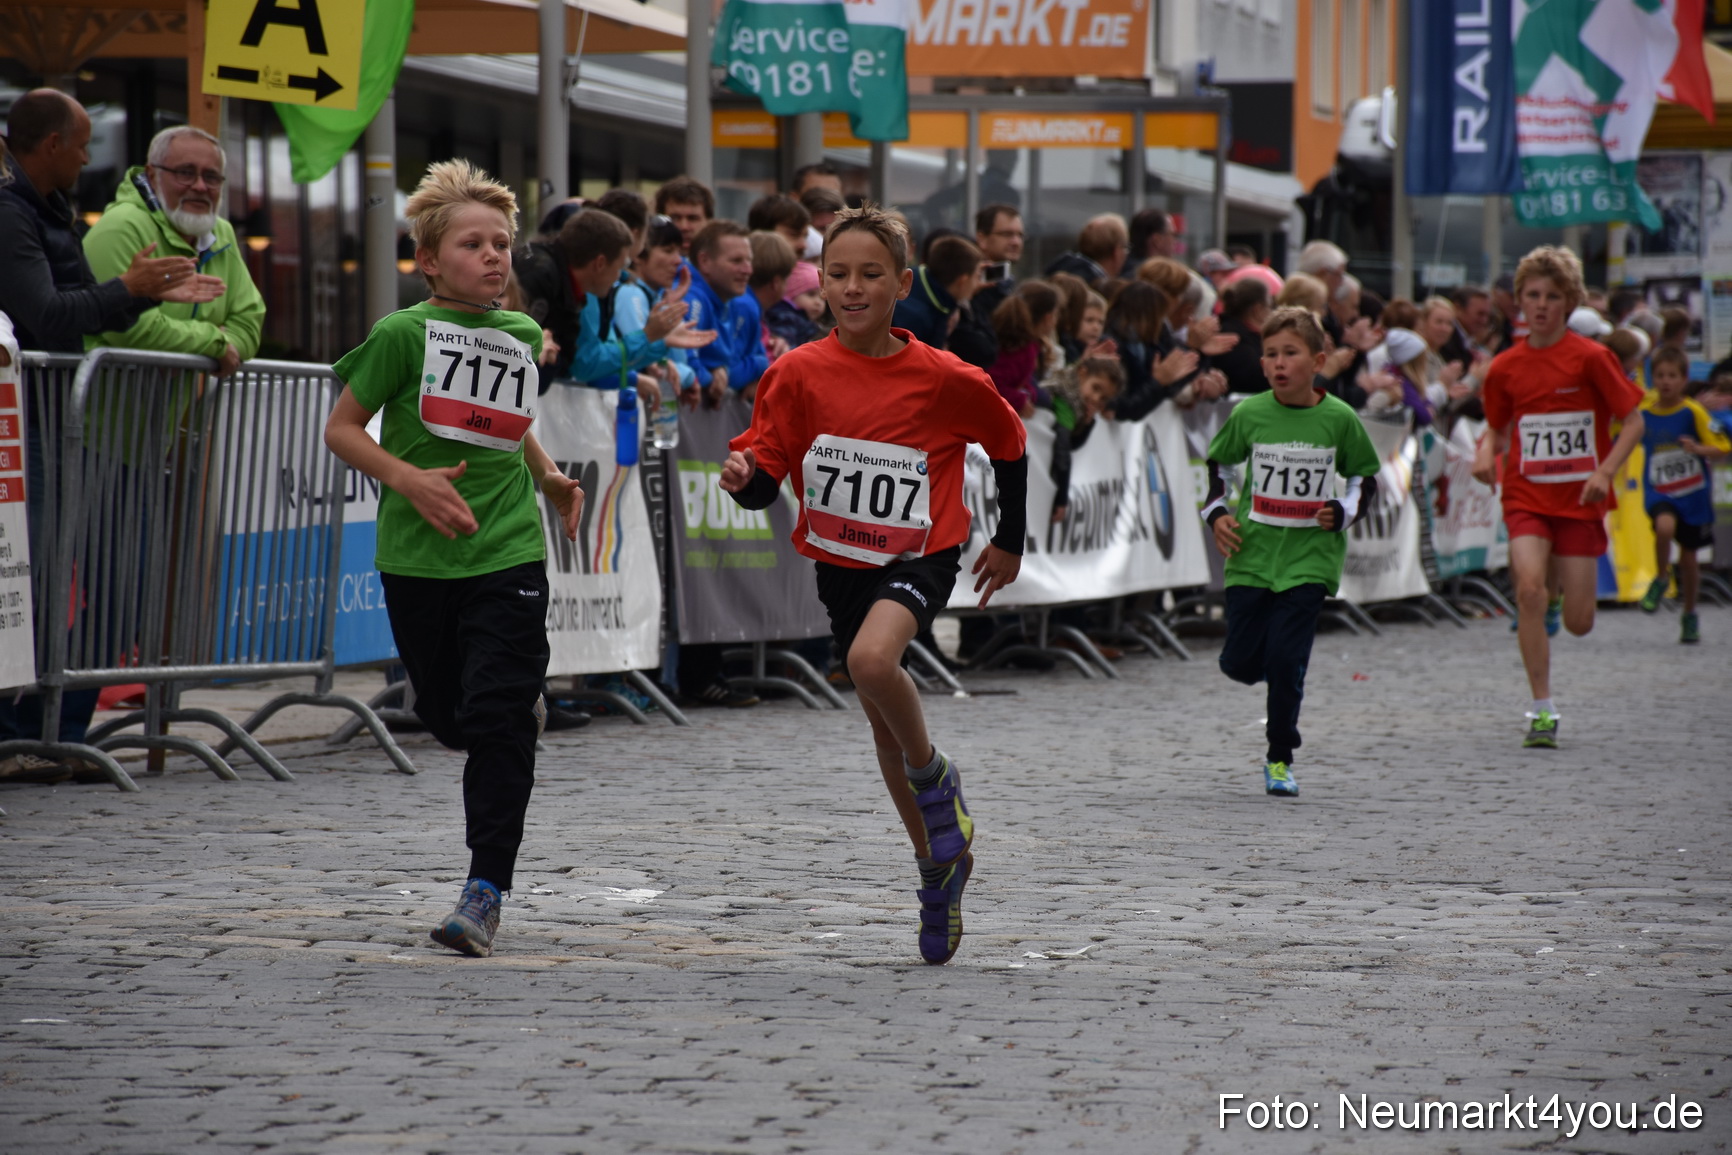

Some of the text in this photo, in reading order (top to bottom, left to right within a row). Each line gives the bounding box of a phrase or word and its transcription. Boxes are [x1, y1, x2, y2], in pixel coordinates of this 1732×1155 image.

[240, 0, 329, 56] A
[429, 330, 523, 360] PARTL Neumarkt
[440, 348, 526, 409] 7171
[466, 410, 492, 431] Jan
[1527, 429, 1588, 457] 7134
[808, 445, 912, 472] PARTL Neumarkt
[1254, 451, 1324, 465] PARTL Neumarkt
[817, 464, 921, 521] 7107
[1260, 464, 1327, 497] 7137
[838, 523, 888, 549] Jamie
